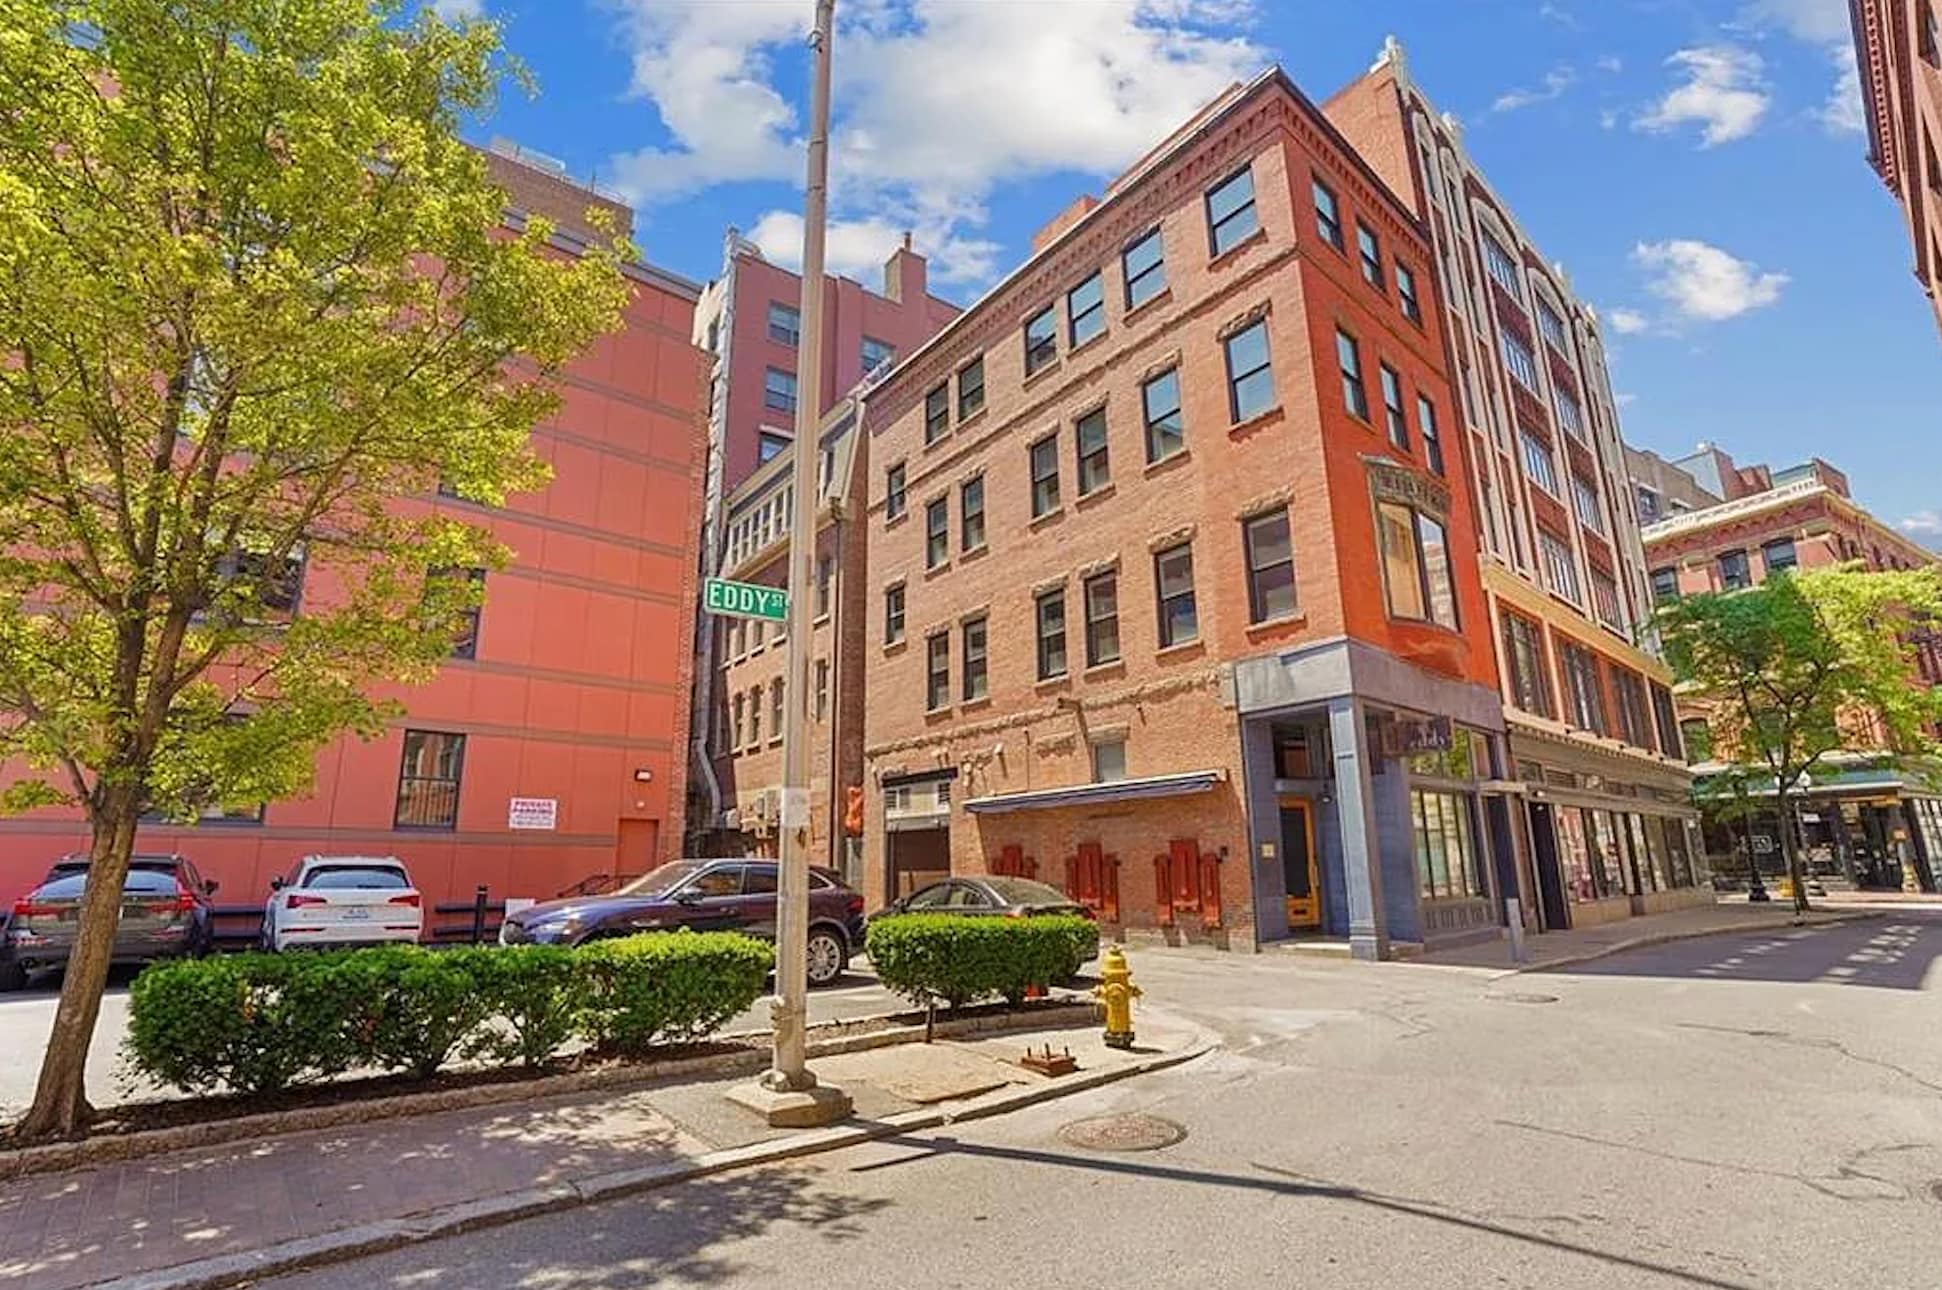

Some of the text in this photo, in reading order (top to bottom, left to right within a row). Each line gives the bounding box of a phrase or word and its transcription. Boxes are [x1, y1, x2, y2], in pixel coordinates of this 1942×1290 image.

[709, 583, 783, 613] EDDY ST
[514, 800, 552, 808] PRIVATE
